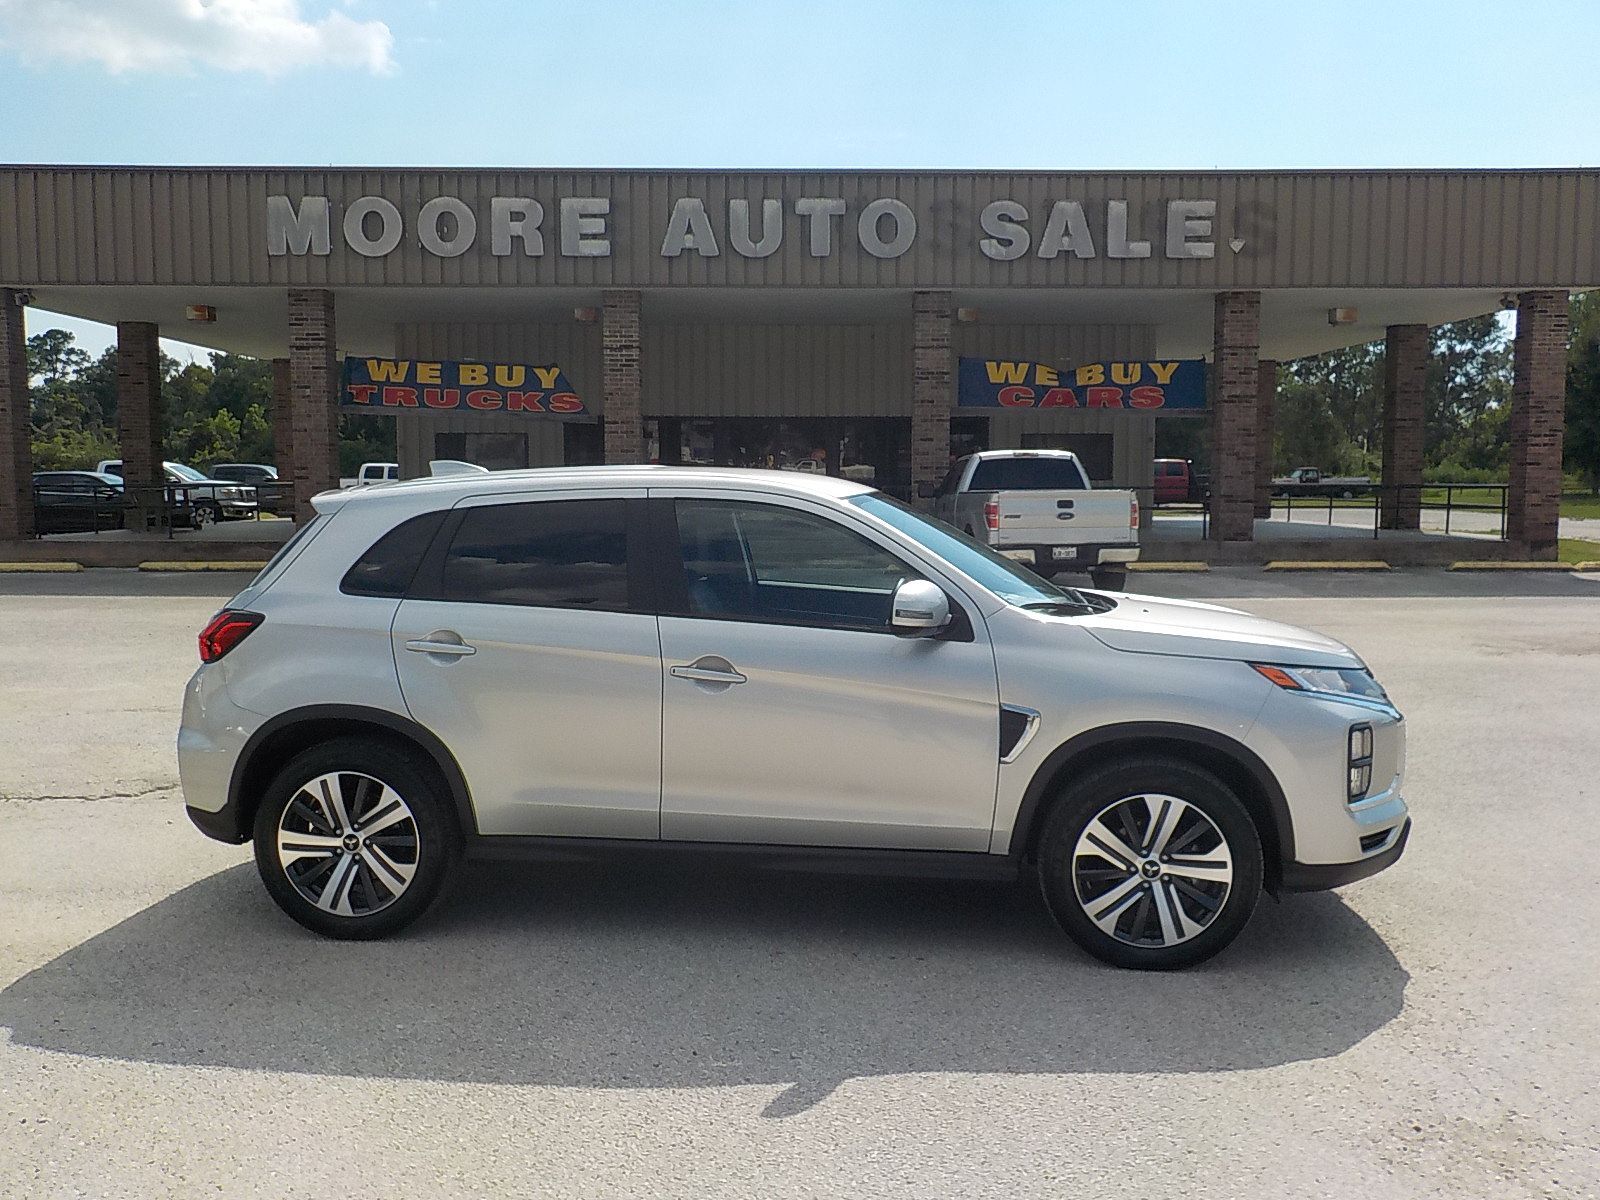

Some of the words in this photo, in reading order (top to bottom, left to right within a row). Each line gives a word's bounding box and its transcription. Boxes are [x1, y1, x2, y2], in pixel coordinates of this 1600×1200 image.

[266, 195, 611, 257] MOORE
[660, 197, 917, 258] AUTO
[366, 359, 442, 385] WE
[459, 364, 561, 389] BUY
[985, 361, 1060, 386] WE
[1075, 361, 1180, 387] BUY
[347, 384, 585, 413] TRUCKS
[998, 386, 1166, 409] CARS
